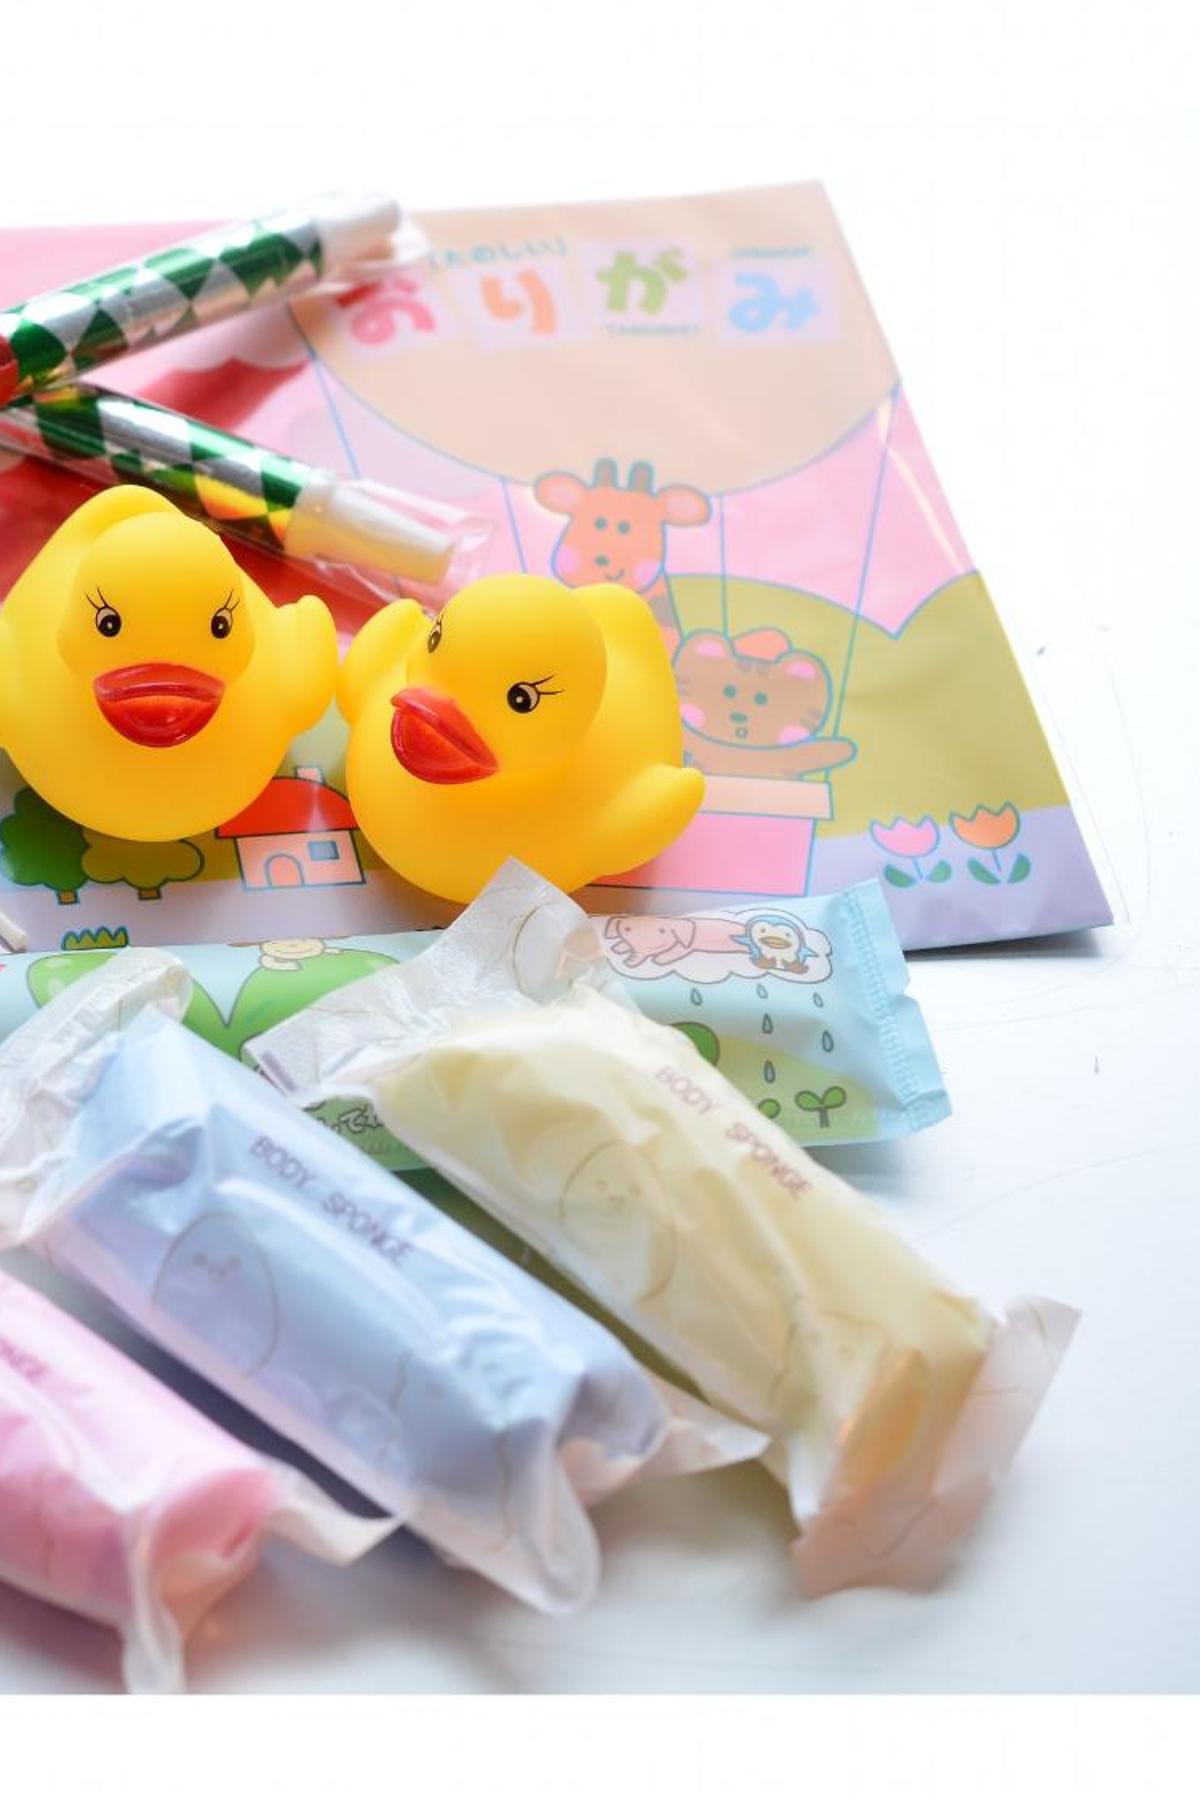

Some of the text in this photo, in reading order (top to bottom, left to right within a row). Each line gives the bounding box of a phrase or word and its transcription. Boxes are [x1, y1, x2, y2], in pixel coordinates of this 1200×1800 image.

[656, 1066, 812, 1199] BODY SPONGE
[251, 1135, 414, 1267] BODY SPONGE
